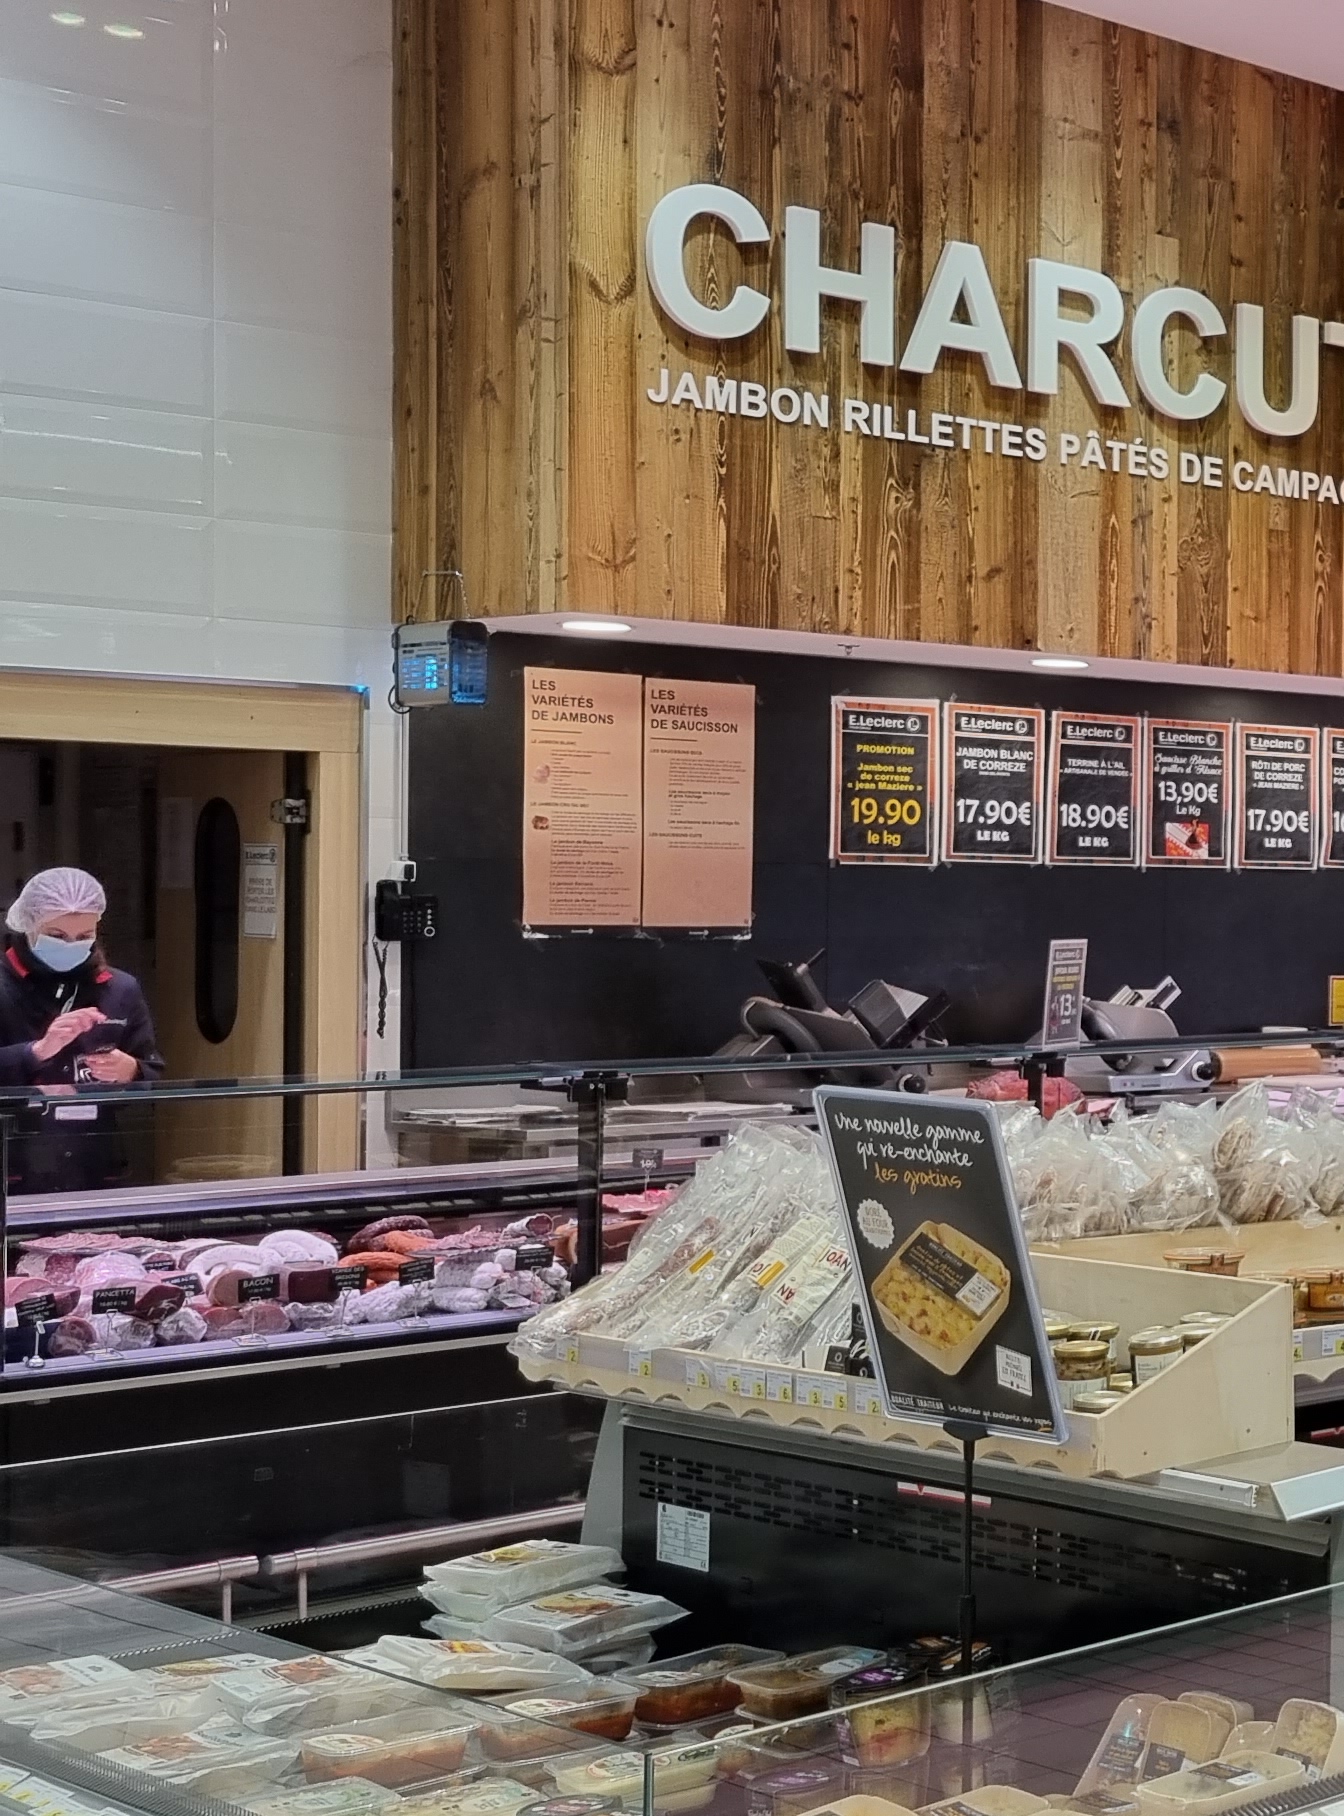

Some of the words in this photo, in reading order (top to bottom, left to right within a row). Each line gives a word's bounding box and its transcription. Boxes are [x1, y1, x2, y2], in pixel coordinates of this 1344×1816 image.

[647, 369, 829, 429] JAMBON
[844, 400, 1047, 461] RILLETTES
[1060, 430, 1170, 480] PÂTÉS
[1181, 450, 1224, 489] DE
[532, 679, 556, 691] LES
[532, 694, 594, 709] VARIÉTÉS
[651, 689, 675, 701] LES
[532, 709, 549, 721] DE
[552, 710, 614, 725] JAMBONS
[651, 703, 708, 717] VARIÉTÉS
[651, 718, 668, 730] DE
[671, 720, 738, 734] SAUCISSON
[849, 714, 904, 730] E.Leclerc
[961, 717, 1014, 731] E.Leclerc
[1067, 726, 1113, 738] E.Leclerc
[1159, 732, 1205, 745] E.Leclerc
[856, 744, 915, 755] PROMOTION
[1250, 737, 1293, 750] E.Leclerc
[956, 747, 998, 759] JAMBON
[1000, 749, 1034, 761] BLANC
[857, 763, 895, 772] Jambon
[963, 760, 977, 769] DE
[979, 761, 1027, 772] CORREZE
[1067, 758, 1099, 768] TERRINE
[1252, 759, 1270, 771] RÔTI
[1271, 762, 1281, 771] DE
[1283, 762, 1305, 773] PORC
[860, 772, 872, 780] de
[1254, 772, 1265, 781] DE
[1267, 772, 1303, 782] CORREZE
[1158, 781, 1218, 803] 13,90€
[851, 798, 921, 825] 19.90
[957, 799, 1031, 826] 17.90€
[1060, 804, 1129, 829] 18.90€
[1176, 805, 1187, 815] Le
[1247, 809, 1309, 833] 17.90€
[867, 830, 880, 845] le
[883, 830, 901, 847] kg
[977, 830, 990, 841] LE
[992, 830, 1009, 842] KG
[1079, 837, 1092, 847] LE
[1094, 837, 1109, 847] KG
[1264, 838, 1277, 848] LE
[1279, 838, 1292, 848] KG
[1060, 993, 1072, 1016] 13
[866, 1116, 922, 1139] nouvelle
[926, 1124, 985, 1149] gamme
[857, 1136, 875, 1169] qui
[874, 1161, 898, 1183] les
[904, 1164, 962, 1195] gratins
[243, 1276, 274, 1288] BACON
[95, 1289, 135, 1298] PANCETTA
